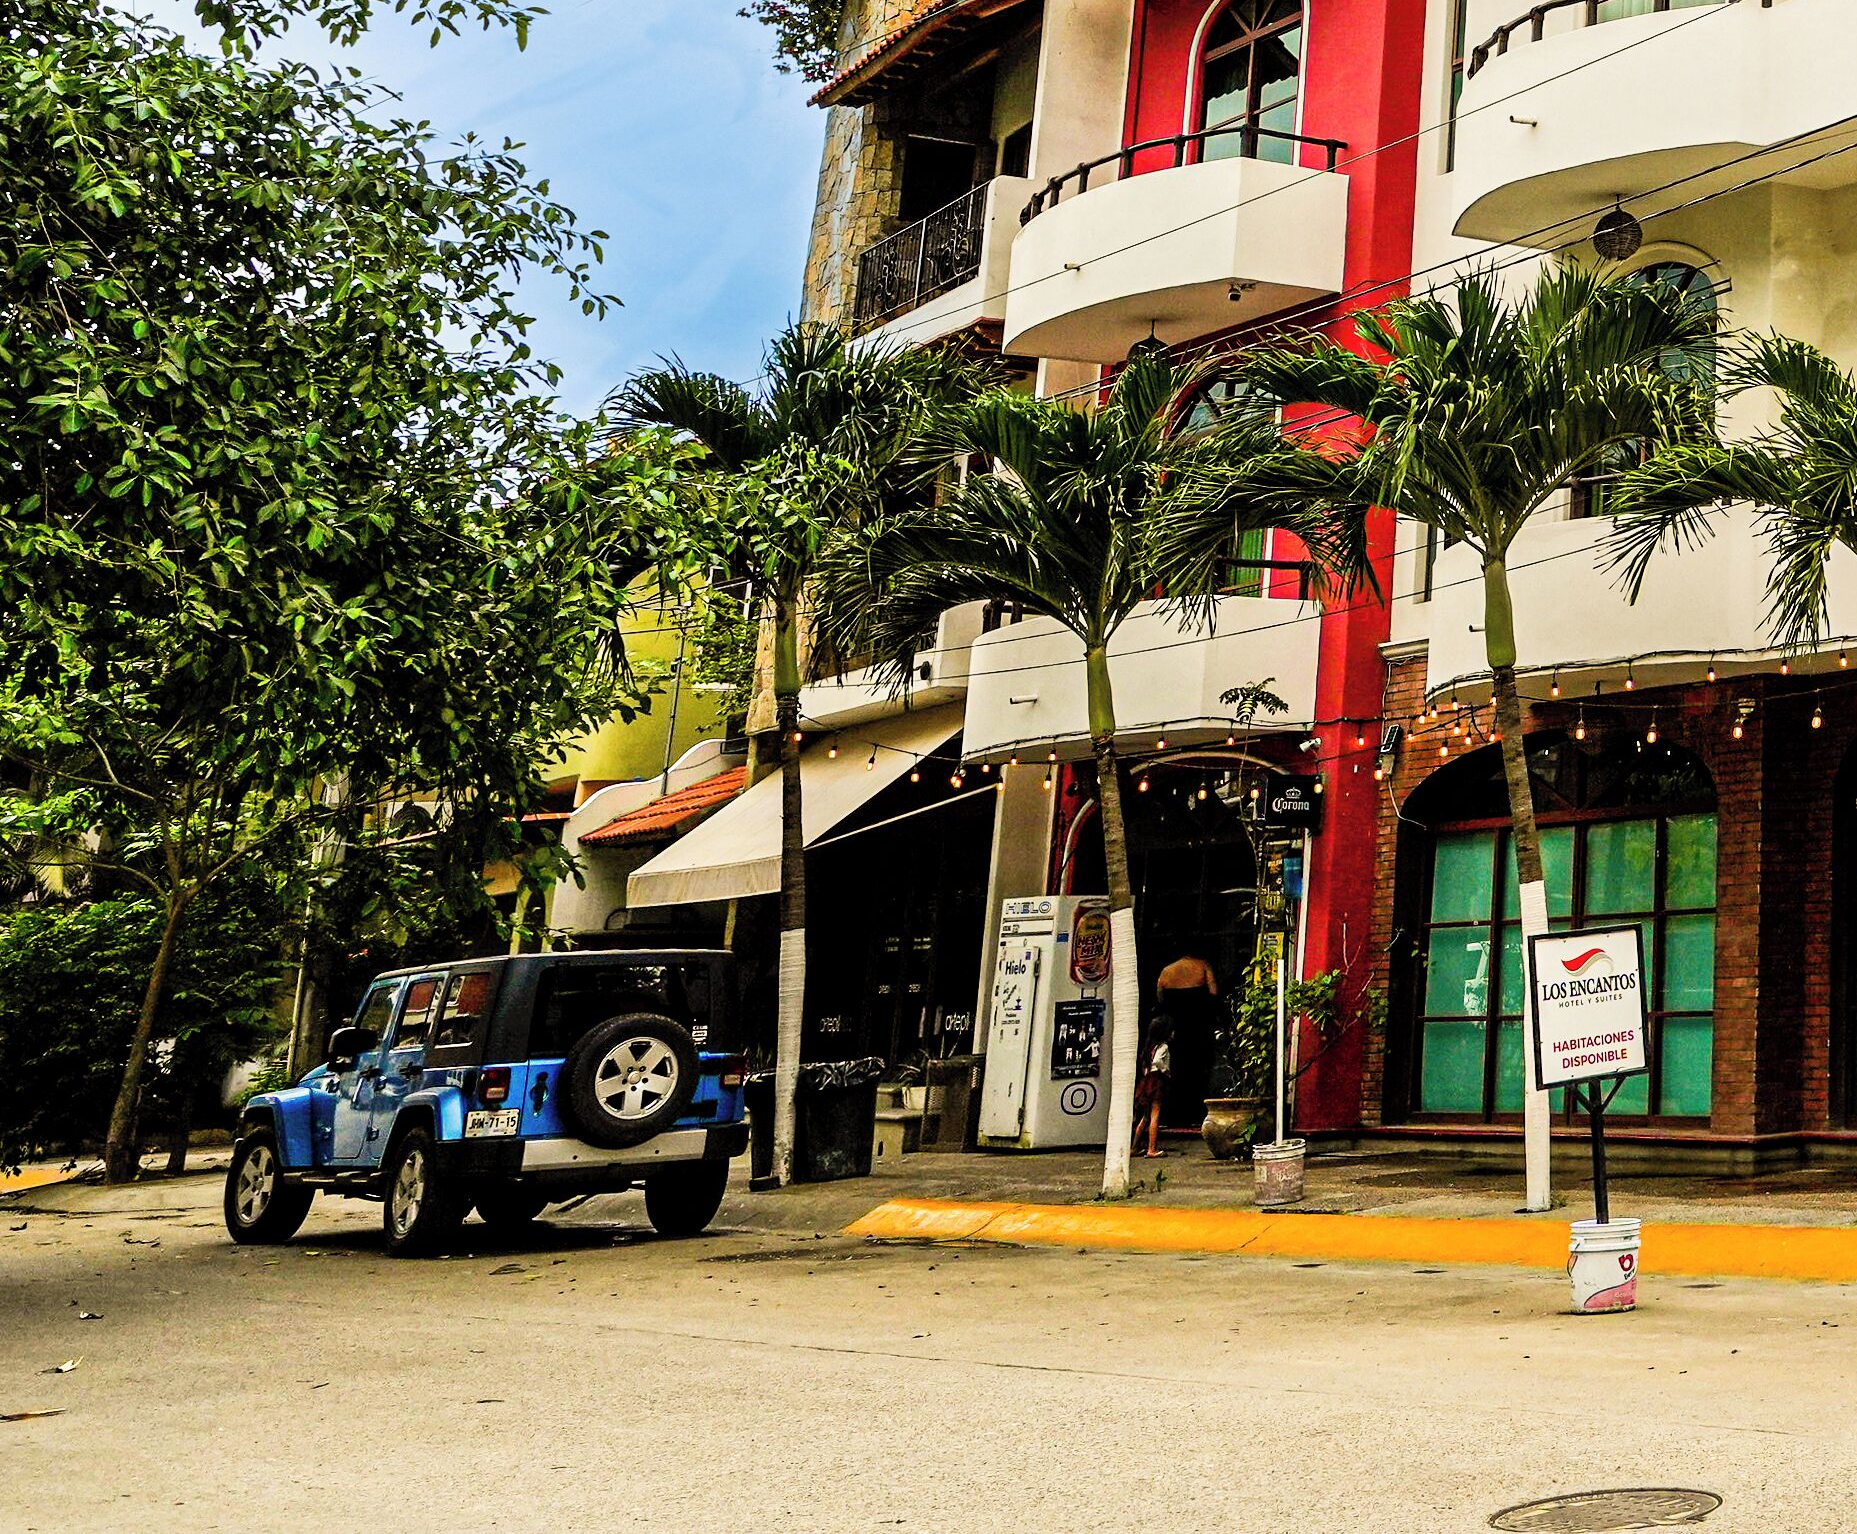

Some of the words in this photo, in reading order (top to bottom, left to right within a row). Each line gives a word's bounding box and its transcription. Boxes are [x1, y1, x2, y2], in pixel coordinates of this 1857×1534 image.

[1271, 797, 1310, 814] Corona
[1005, 901, 1052, 914] HIELO
[1005, 959, 1027, 976] Hielo
[1542, 981, 1567, 1002] LOS
[1568, 972, 1636, 998] ENCANTOS
[1558, 999, 1584, 1008] HOTEL
[1595, 993, 1623, 1003] SUITES
[1553, 1029, 1635, 1053] HABITACIONES
[1562, 1048, 1628, 1069] DISPONIBLE
